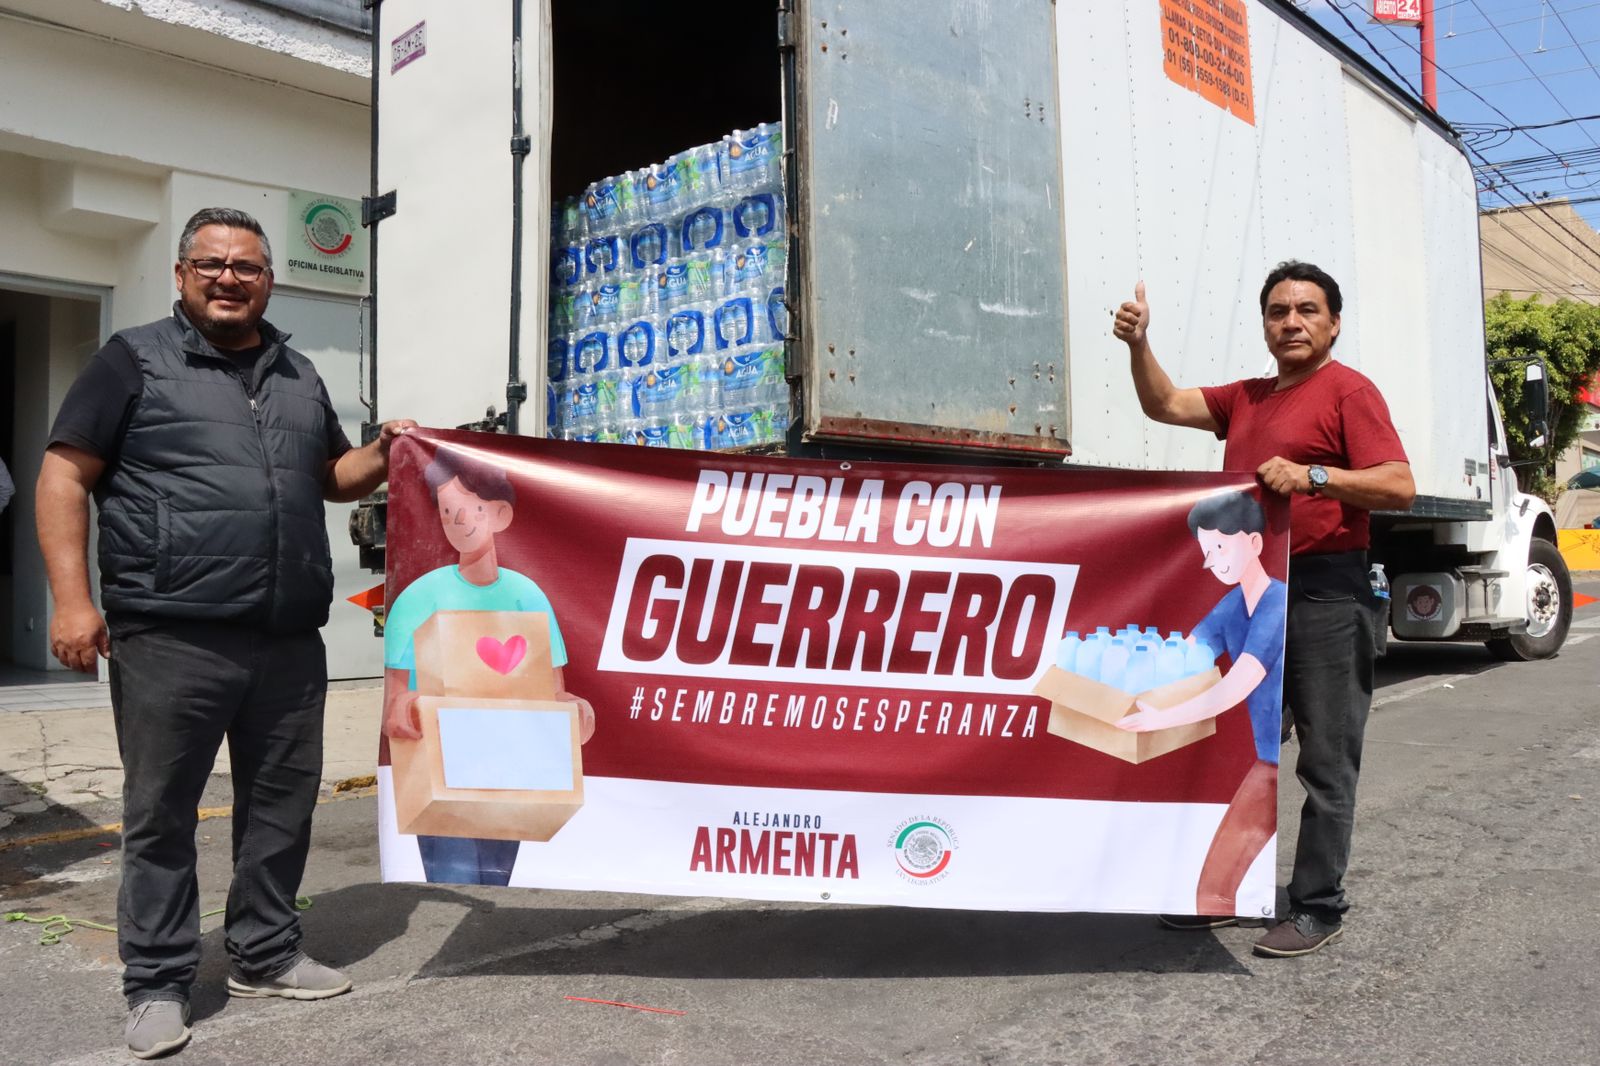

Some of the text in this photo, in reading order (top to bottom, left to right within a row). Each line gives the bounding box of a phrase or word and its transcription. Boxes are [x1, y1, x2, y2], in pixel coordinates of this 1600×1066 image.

[1398, 0, 1420, 12] 24
[1167, 48, 1177, 66] 01
[745, 146, 769, 162] AGUA
[288, 259, 364, 278] OFICINA LEGISLATIVA
[736, 365, 759, 379] AGUA
[685, 469, 1002, 548] PUEBLA CON
[621, 553, 1056, 681] GUERRERO
[629, 686, 1039, 738] #SEMBREMOSESPERANZA
[733, 811, 821, 830] ALEJANDRO
[887, 820, 908, 848] SENADO
[689, 826, 859, 879] ARMENTA
